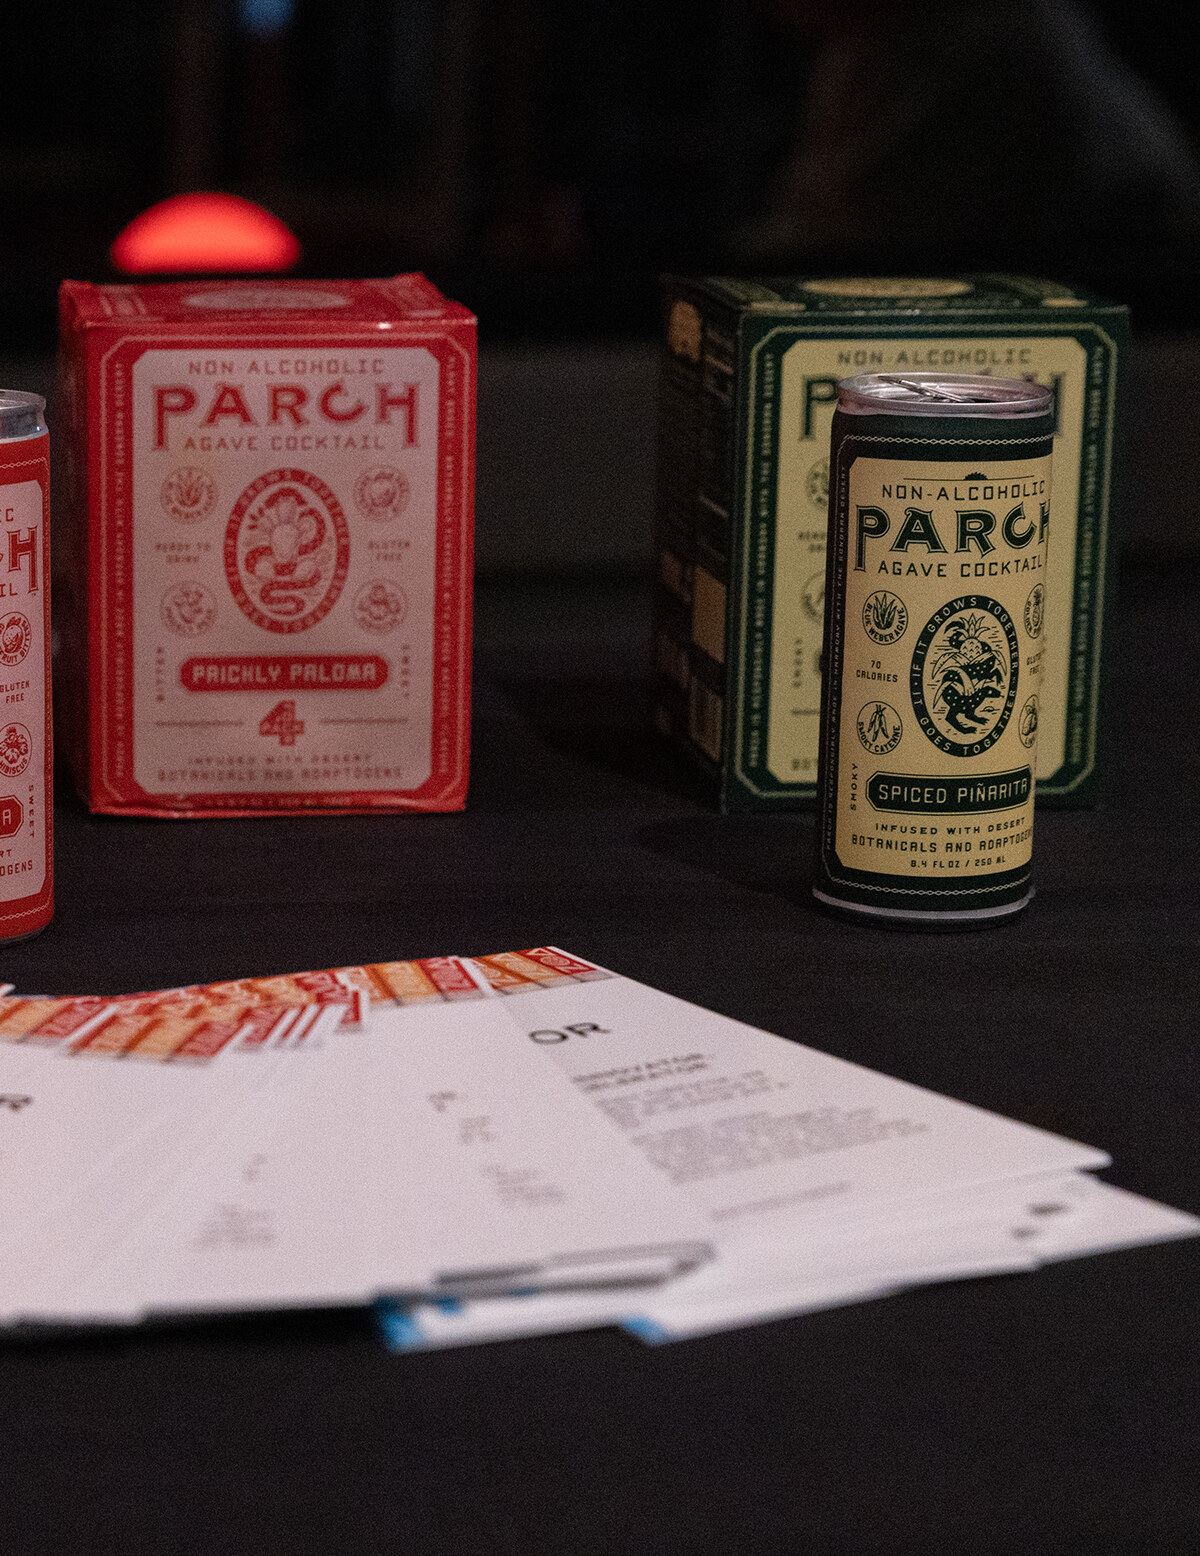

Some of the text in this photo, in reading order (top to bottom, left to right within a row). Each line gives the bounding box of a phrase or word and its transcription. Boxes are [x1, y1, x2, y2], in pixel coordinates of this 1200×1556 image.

[153, 380, 419, 450] PARCH
[184, 435, 385, 450] AGAVE COCKTAIL
[882, 480, 1046, 501] NON-ALCOHOLIC
[878, 554, 1043, 577] AGAVE COCKTAIL
[868, 626, 895, 642] WEBER
[893, 607, 906, 635] AGAVE
[916, 640, 927, 655] IT
[927, 597, 977, 633] GROWS
[193, 663, 377, 683] PRICKLY PALOMA
[871, 660, 881, 669] 70
[856, 670, 898, 682] CALORIES
[0, 680, 30, 693] GLUTEN
[5, 693, 25, 704] FREE
[919, 716, 951, 752] GOES
[962, 689, 1017, 756] TOGETHER
[858, 721, 901, 752] SMOKY CAYENNE
[879, 776, 1028, 804] SPICED PIÑARITA
[876, 817, 1026, 835] INFUSED WITH DESERT
[852, 834, 937, 852] BOTANICALS
[945, 842, 972, 852] AND
[910, 859, 927, 868] 8.4
[975, 857, 992, 866] 250
